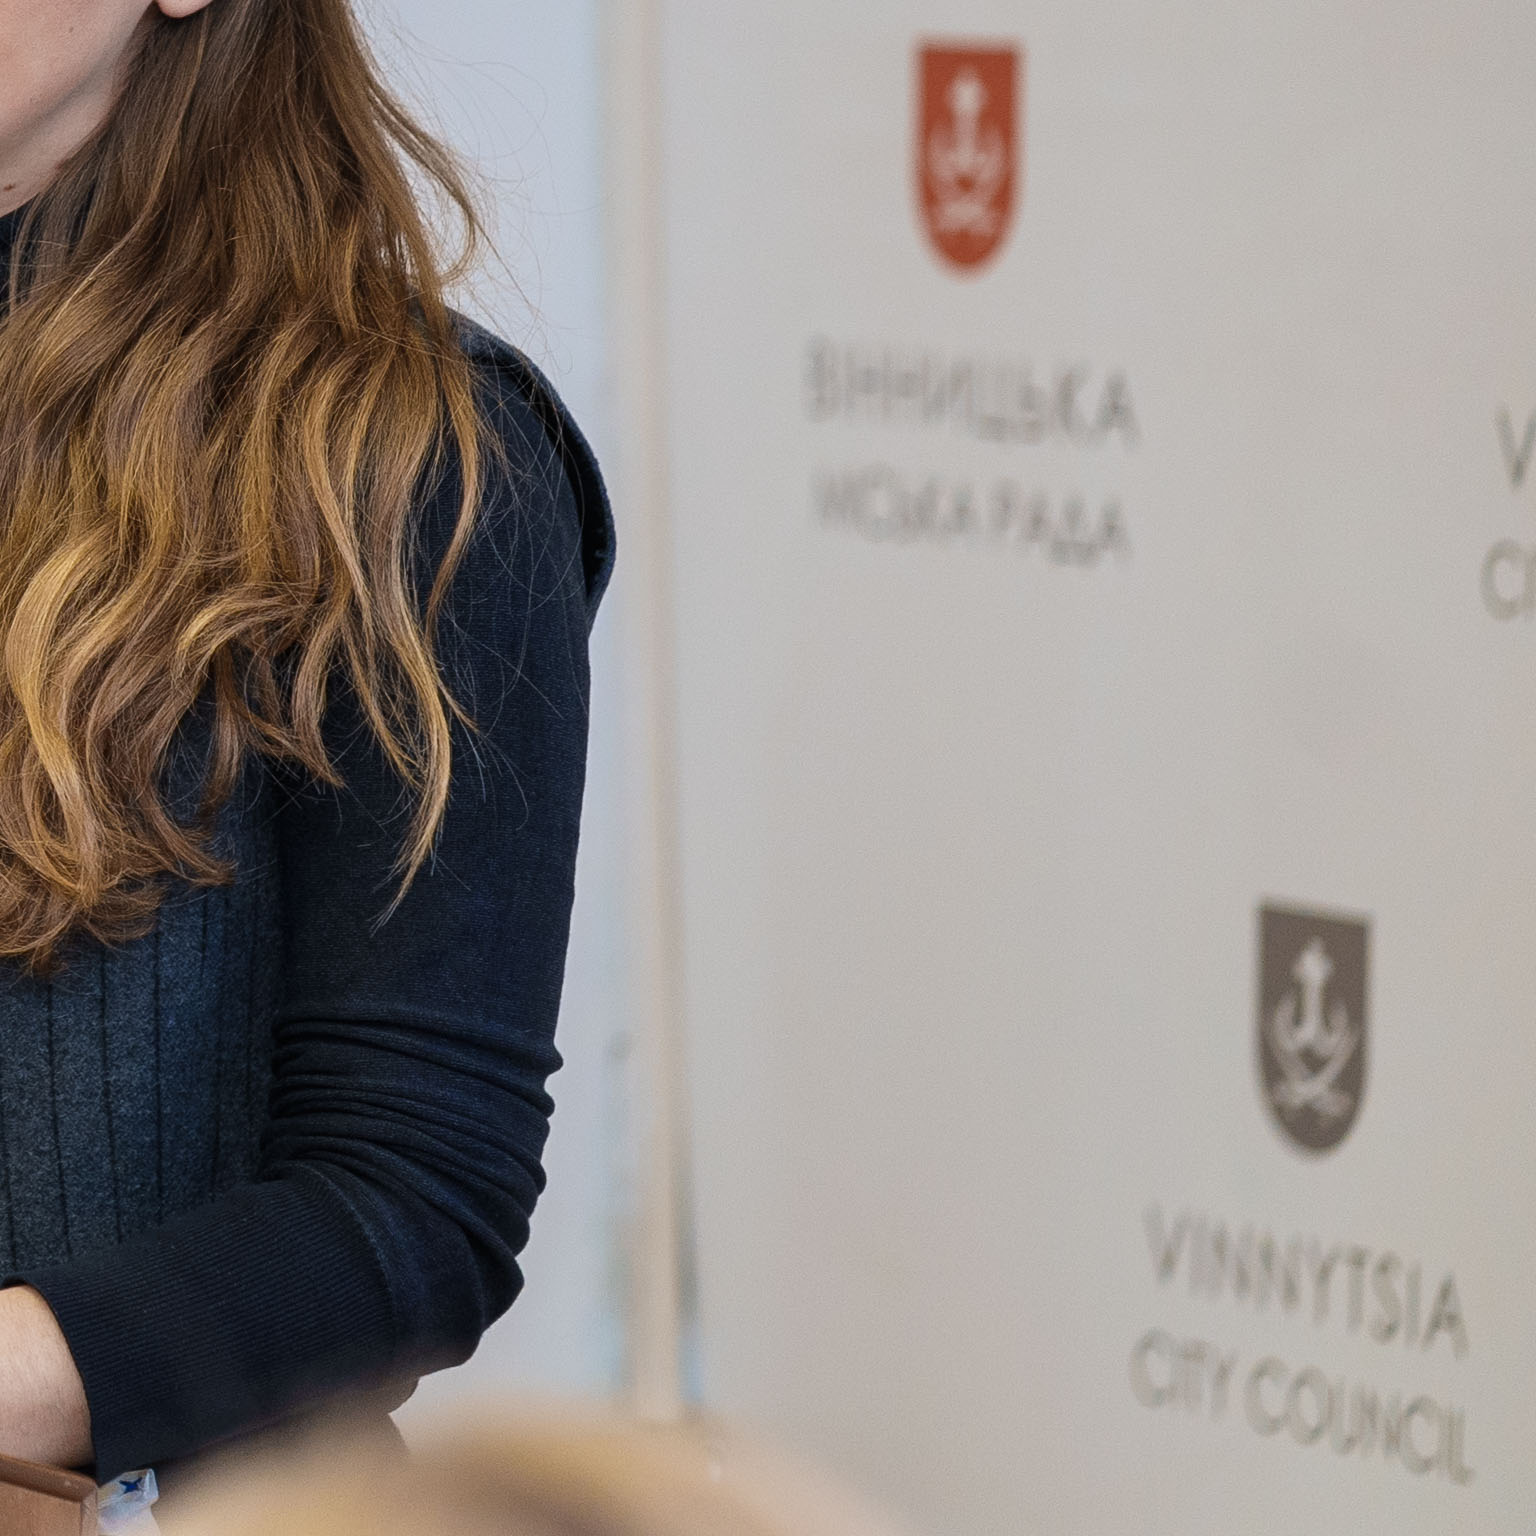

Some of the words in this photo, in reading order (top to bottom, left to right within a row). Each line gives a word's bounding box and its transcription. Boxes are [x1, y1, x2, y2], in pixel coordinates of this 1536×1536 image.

[1144, 1204, 1468, 1358] VINNYTSIA
[1132, 1328, 1237, 1418] CITY
[1248, 1360, 1474, 1484] COUNCIL
